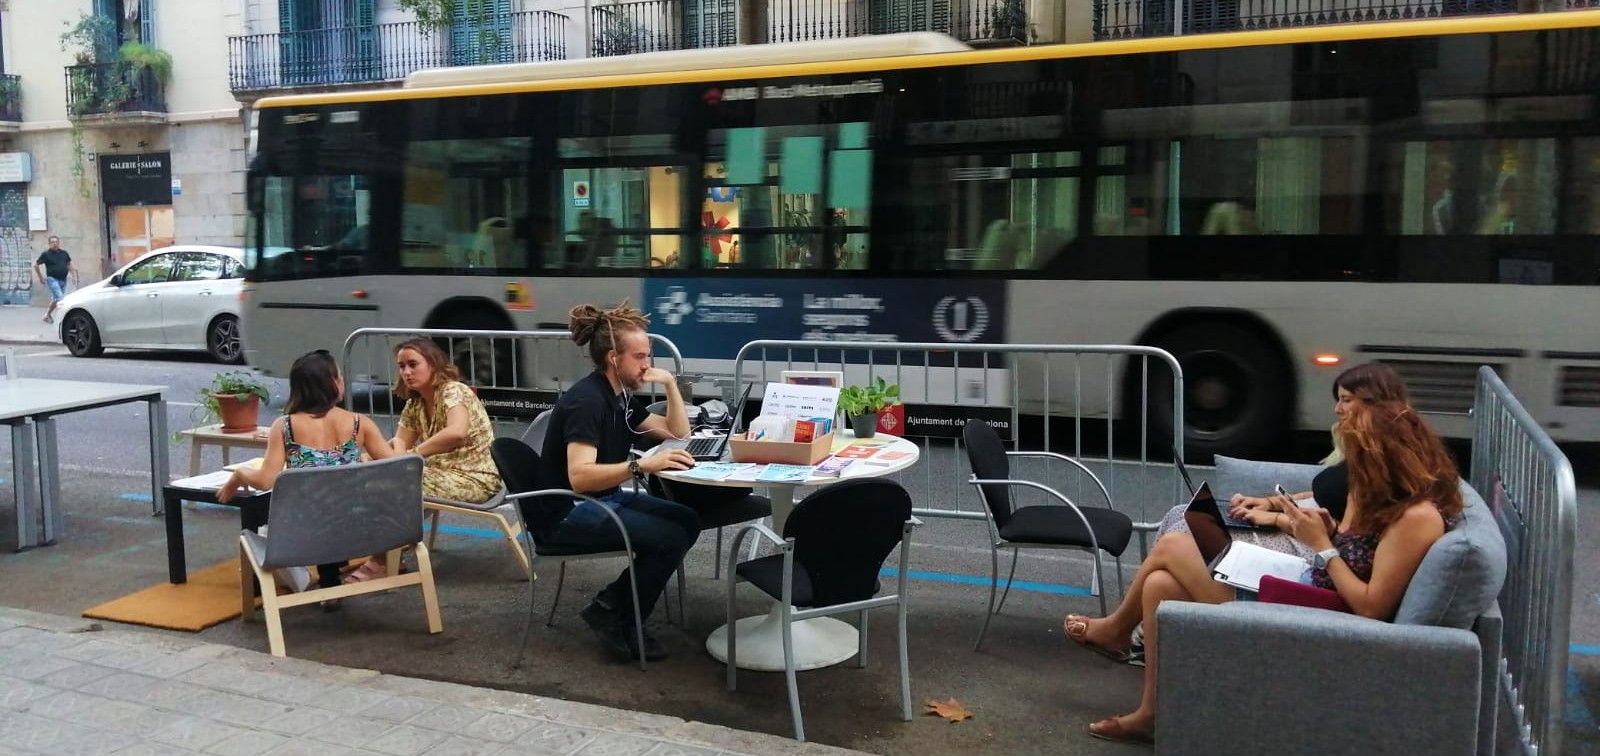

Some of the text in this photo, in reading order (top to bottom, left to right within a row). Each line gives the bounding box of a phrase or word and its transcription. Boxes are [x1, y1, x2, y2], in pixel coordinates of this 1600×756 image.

[110, 160, 161, 169] GALERIE SALON
[907, 416, 953, 427] Ajuntament
[955, 417, 965, 426] de
